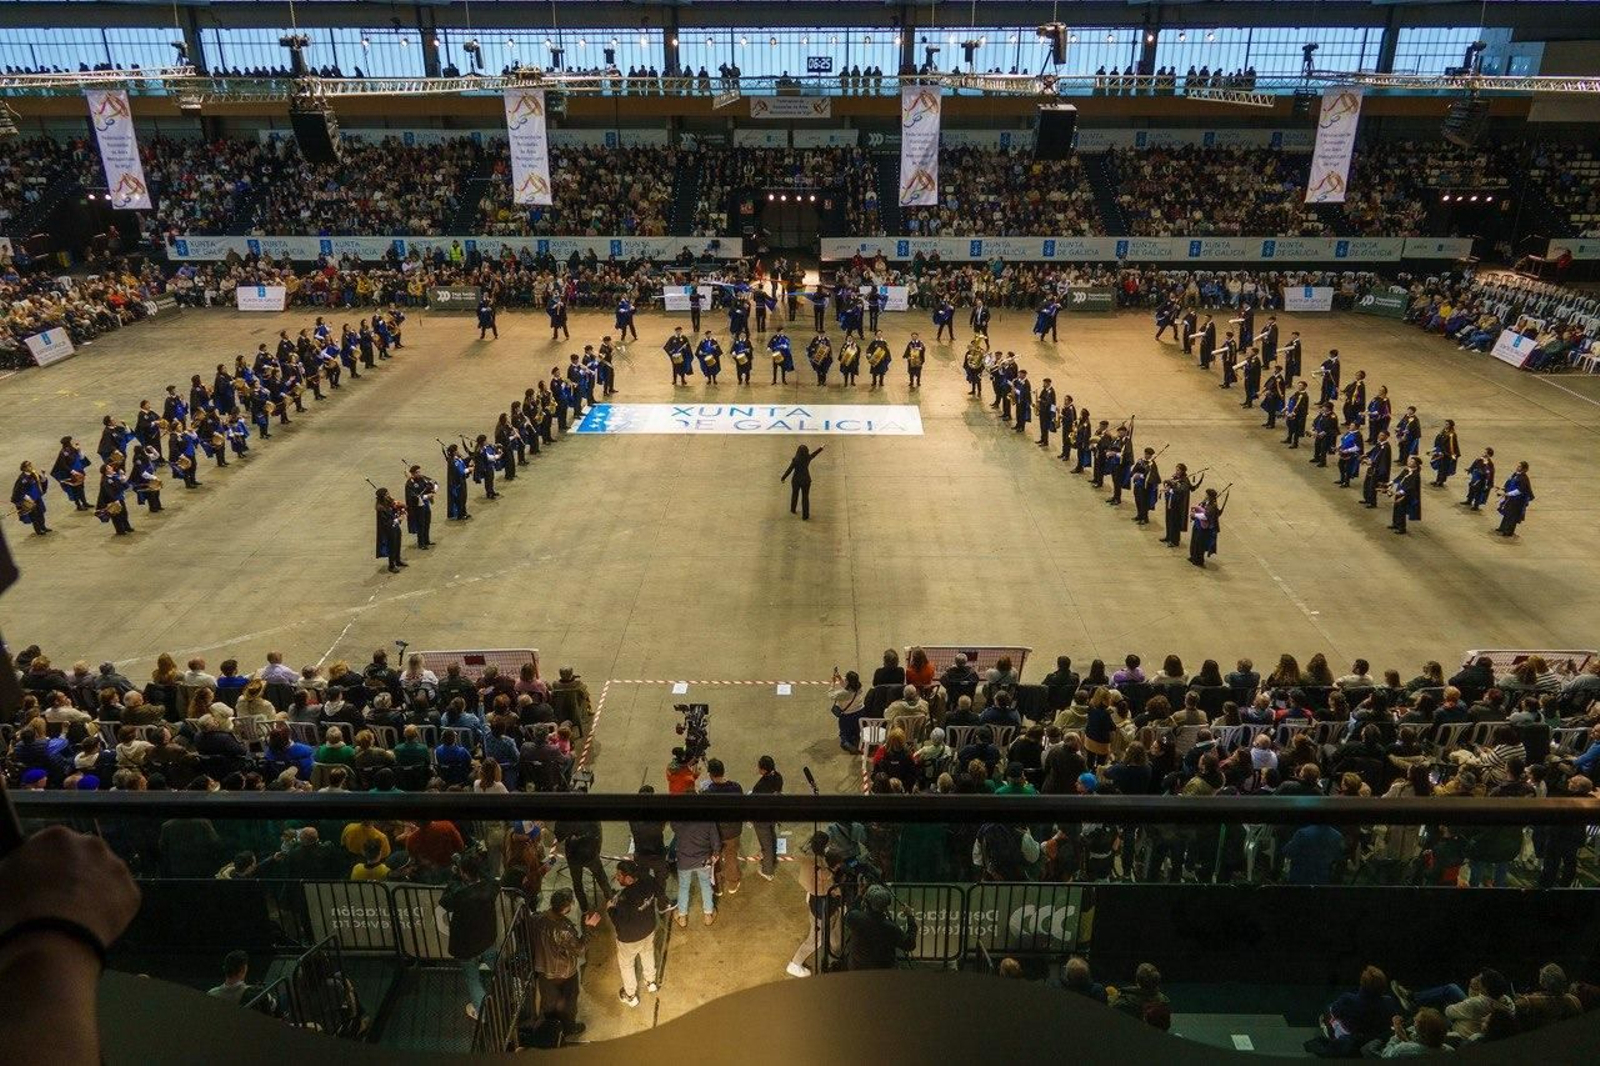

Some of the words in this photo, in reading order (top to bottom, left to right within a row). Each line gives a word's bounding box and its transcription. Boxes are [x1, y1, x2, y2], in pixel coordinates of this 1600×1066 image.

[808, 58, 831, 70] 06:25
[671, 406, 812, 417] XUNTA
[734, 419, 907, 431] GALICIA
